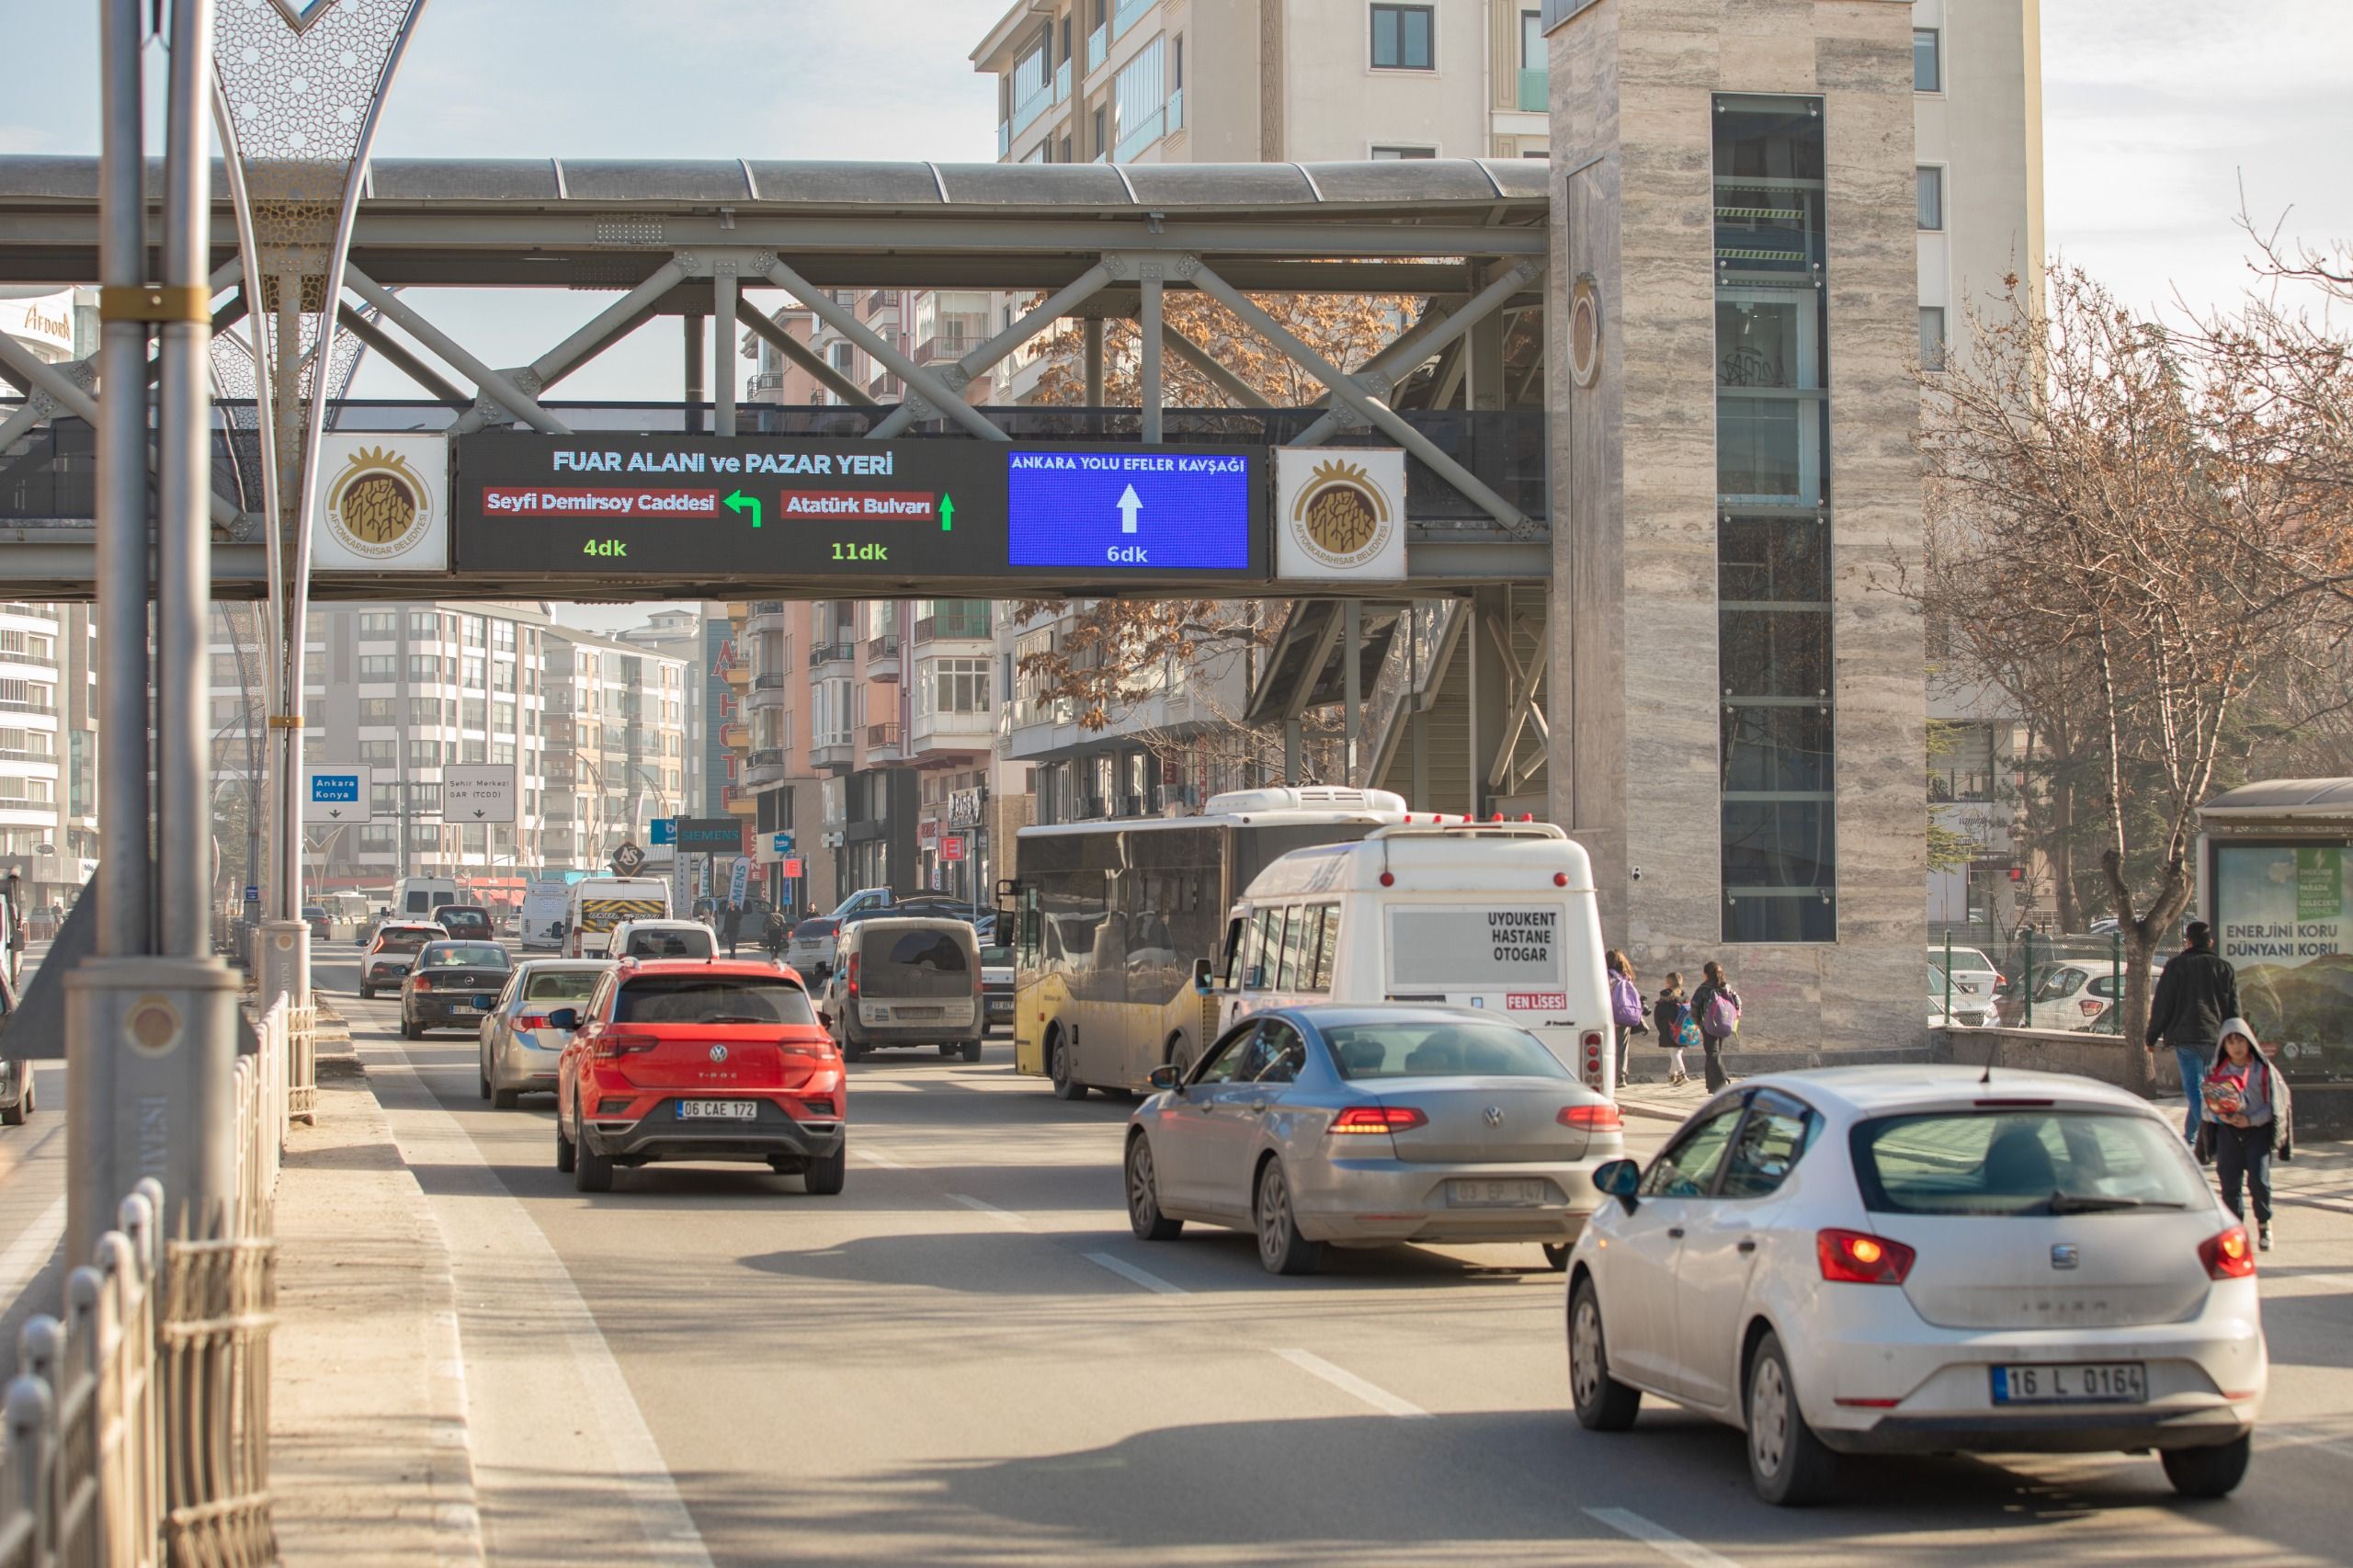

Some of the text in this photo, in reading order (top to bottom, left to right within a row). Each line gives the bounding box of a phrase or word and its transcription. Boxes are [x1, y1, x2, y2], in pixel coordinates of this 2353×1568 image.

[553, 450, 893, 475] FUAR ALANI ve PAZAR YERİ
[1011, 456, 1245, 475] ANKARA YOLU EFELER KAVŞAĞI
[487, 493, 715, 513] Seyfi Demirsoy Caddesi
[786, 496, 930, 515] Atatürk Bulvarı
[329, 513, 428, 555] AFYONKARAHİSAR BELEDİYESİ
[583, 540, 628, 557] 4dk
[832, 542, 888, 561] 11dk
[1295, 524, 1388, 565] AFYONKARAHİSAR BELEDİYESİ
[1107, 546, 1148, 563] 6dk
[476, 779, 510, 788] Merkezi
[315, 790, 349, 800] Konya
[472, 790, 502, 800] (TCDD)
[680, 830, 740, 841] SIEMENS
[1488, 912, 1556, 926] UYDUKENT
[1492, 929, 1552, 944] HASTANE
[2226, 921, 2337, 938] ENERJİNİ KORU
[1494, 947, 1548, 961] OTOGAR
[2226, 940, 2338, 957] DÜNYANI KORU
[1507, 995, 1529, 1009] FEN
[685, 1103, 754, 1116] 06 CAE 172
[2009, 1369, 2141, 1395] 16 L 0164
